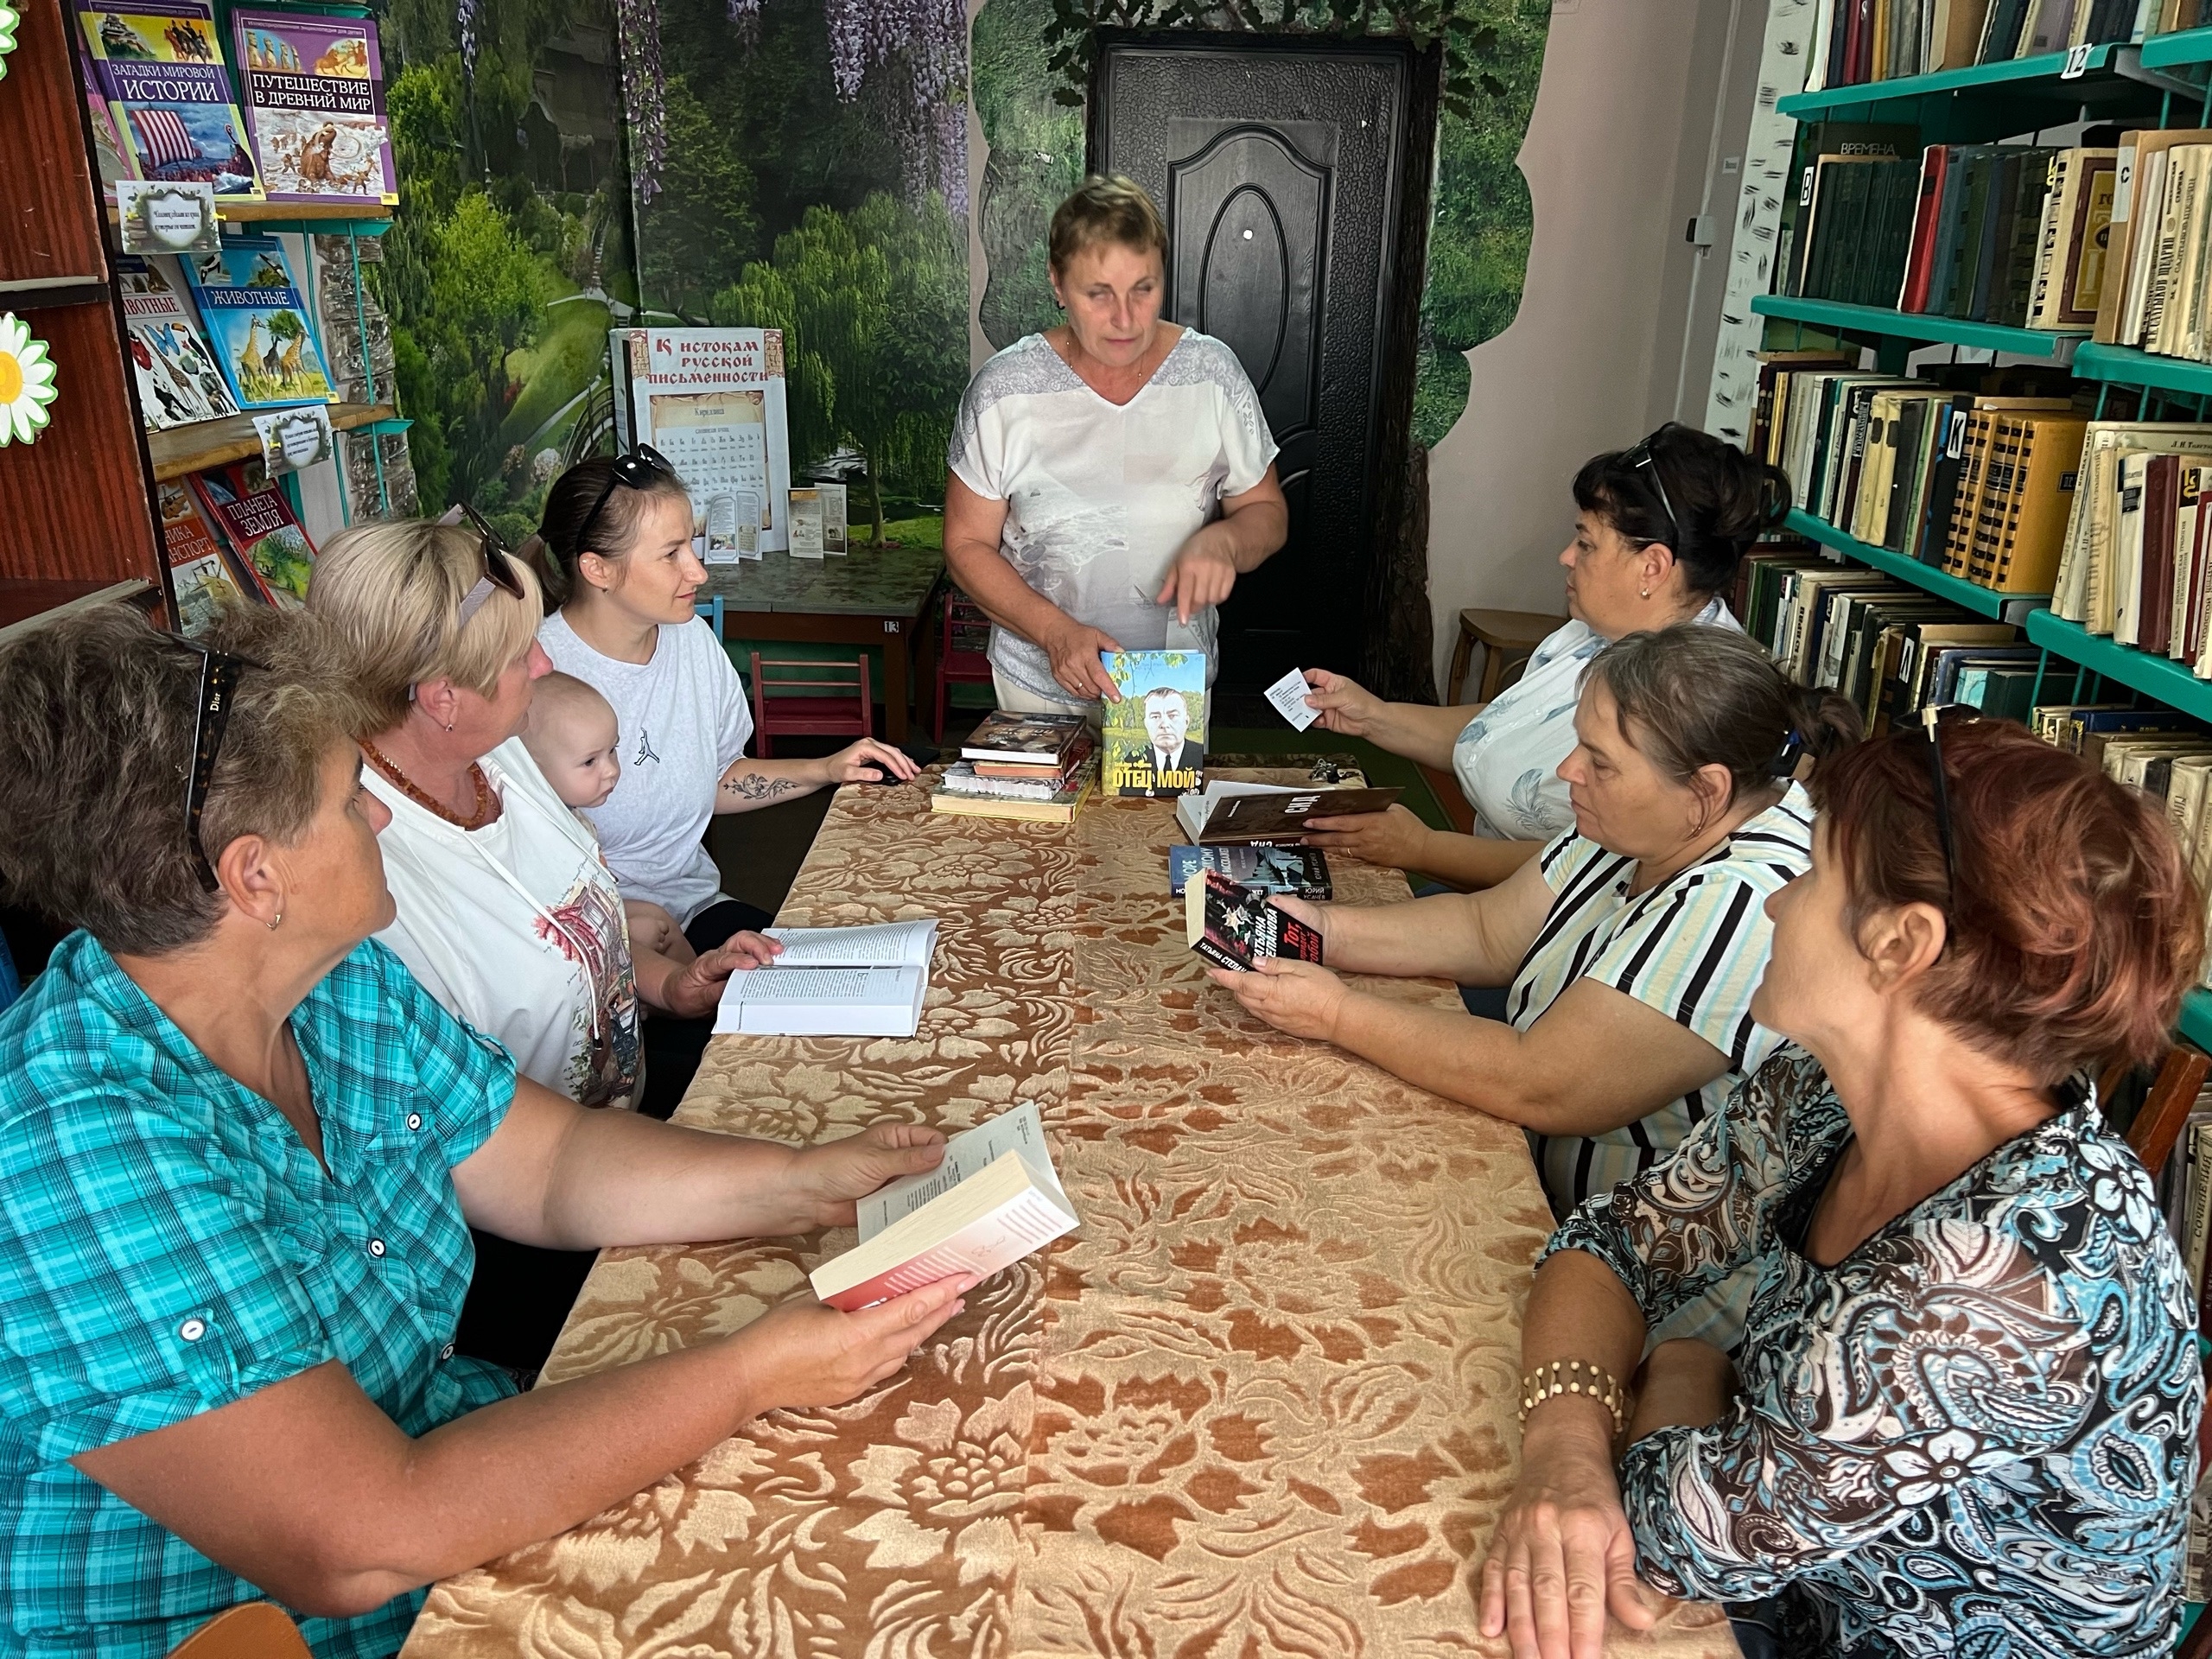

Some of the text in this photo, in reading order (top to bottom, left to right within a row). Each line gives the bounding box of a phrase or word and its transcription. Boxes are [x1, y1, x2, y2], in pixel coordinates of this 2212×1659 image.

[112, 63, 216, 79] ЗАГАДКИ МИРОВОЙ
[2066, 47, 2087, 73] 12
[122, 79, 219, 102] ИСТОРИИ
[252, 74, 370, 95] ПУТЕШЕСТВИЕ
[254, 91, 371, 111] В ДРЕВНИЙ МИР
[1840, 143, 1896, 156] ВРЕМЕНА
[1802, 173, 1812, 201] В
[2175, 169, 2184, 203] СТАРИНА
[212, 290, 290, 305] ЖИВОТНЫЕ
[657, 339, 672, 356] К
[1950, 418, 1964, 452] К
[226, 493, 277, 520] ПЛАНЕТА
[240, 509, 283, 537] ЗЕМЛЯ
[886, 622, 899, 632] 13
[210, 692, 221, 712] Dior
[1113, 767, 1195, 791] ОТЕЦ МОЙ
[1200, 942, 1222, 960] ТАТЬЯНА
[2195, 1155, 2212, 1238] СОЧИНЕНИЯ
